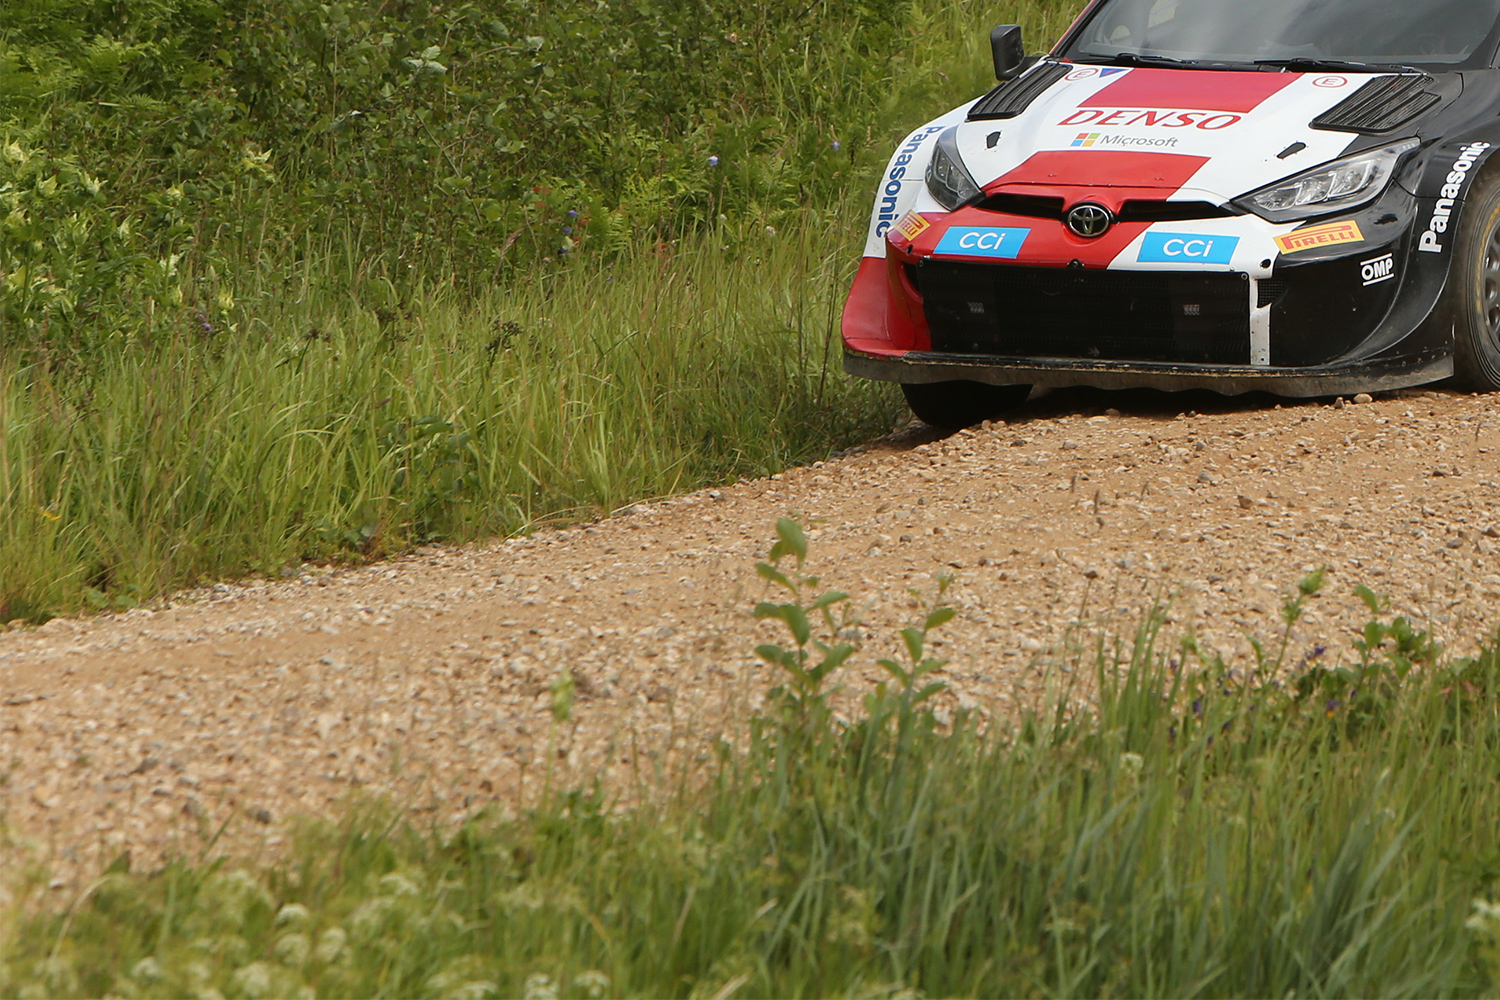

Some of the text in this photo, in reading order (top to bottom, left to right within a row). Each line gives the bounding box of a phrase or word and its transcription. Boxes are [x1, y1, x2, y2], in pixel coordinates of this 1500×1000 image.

[1056, 109, 1242, 130] DENSO
[1100, 134, 1179, 148] Microsoft
[876, 125, 946, 239] Panasonic
[1418, 140, 1492, 253] Panasonic
[1281, 224, 1356, 250] PIRELLI
[1360, 257, 1394, 281] OMP
